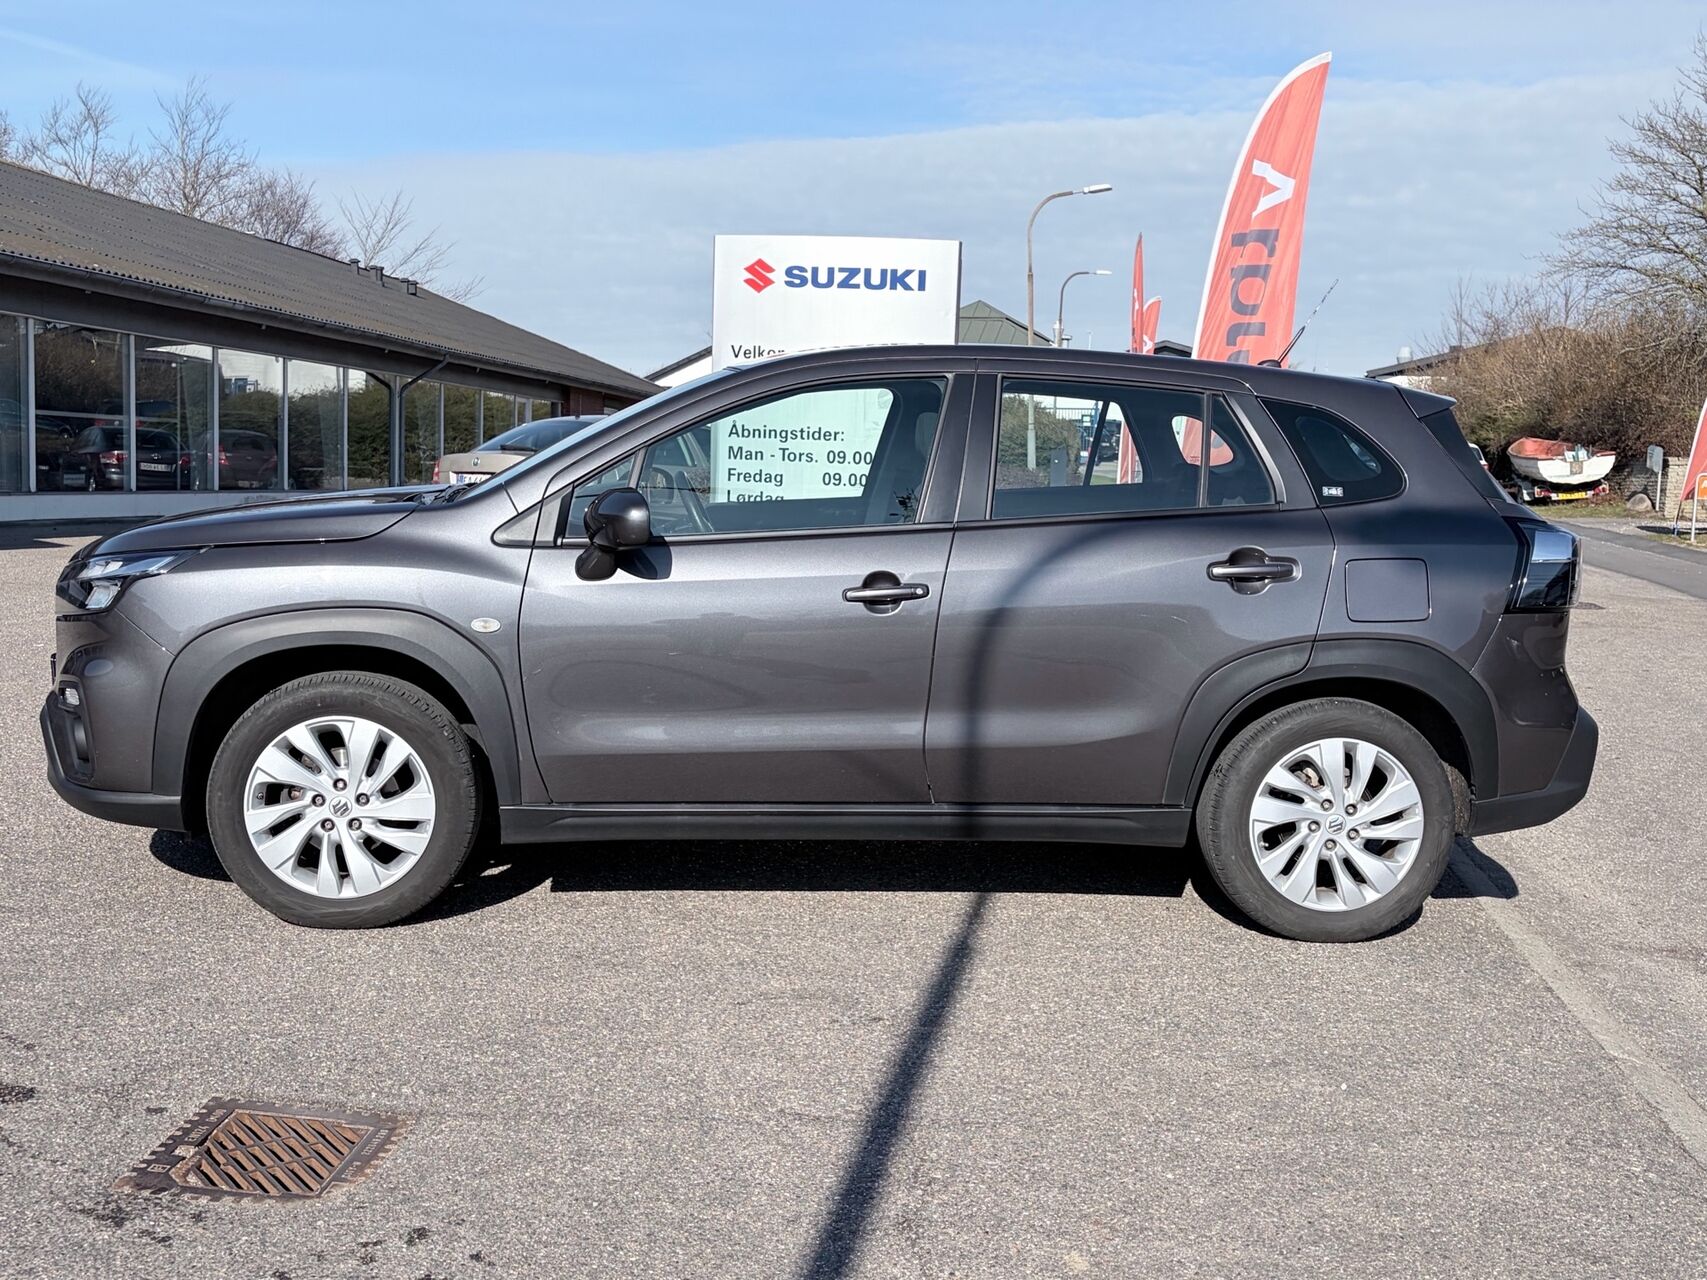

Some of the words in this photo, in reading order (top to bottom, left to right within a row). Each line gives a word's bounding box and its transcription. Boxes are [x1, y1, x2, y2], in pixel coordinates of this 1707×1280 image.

[784, 265, 927, 292] SUZUKI
[728, 420, 845, 443] Åbningstider:
[728, 446, 764, 460] Man
[779, 448, 819, 463] Tors.
[826, 450, 873, 465] 09.00
[727, 467, 783, 487] Fredag
[822, 472, 868, 487] 09.00
